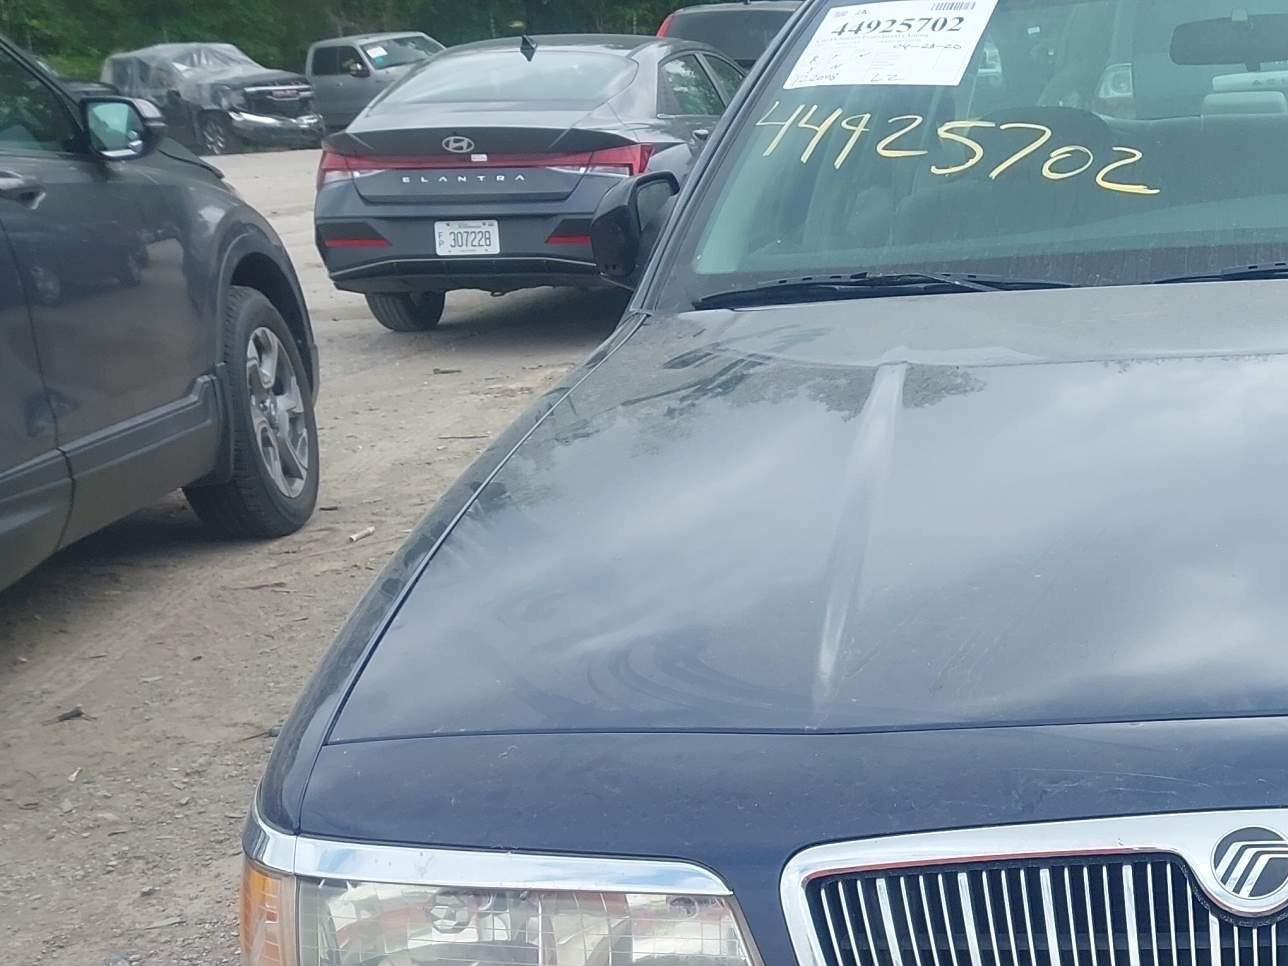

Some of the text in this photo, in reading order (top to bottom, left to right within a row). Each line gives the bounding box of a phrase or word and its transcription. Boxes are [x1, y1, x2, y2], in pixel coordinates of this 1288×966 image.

[831, 17, 965, 36] 44925702
[756, 101, 1161, 194] 44925702
[402, 174, 525, 183] ELANTRA
